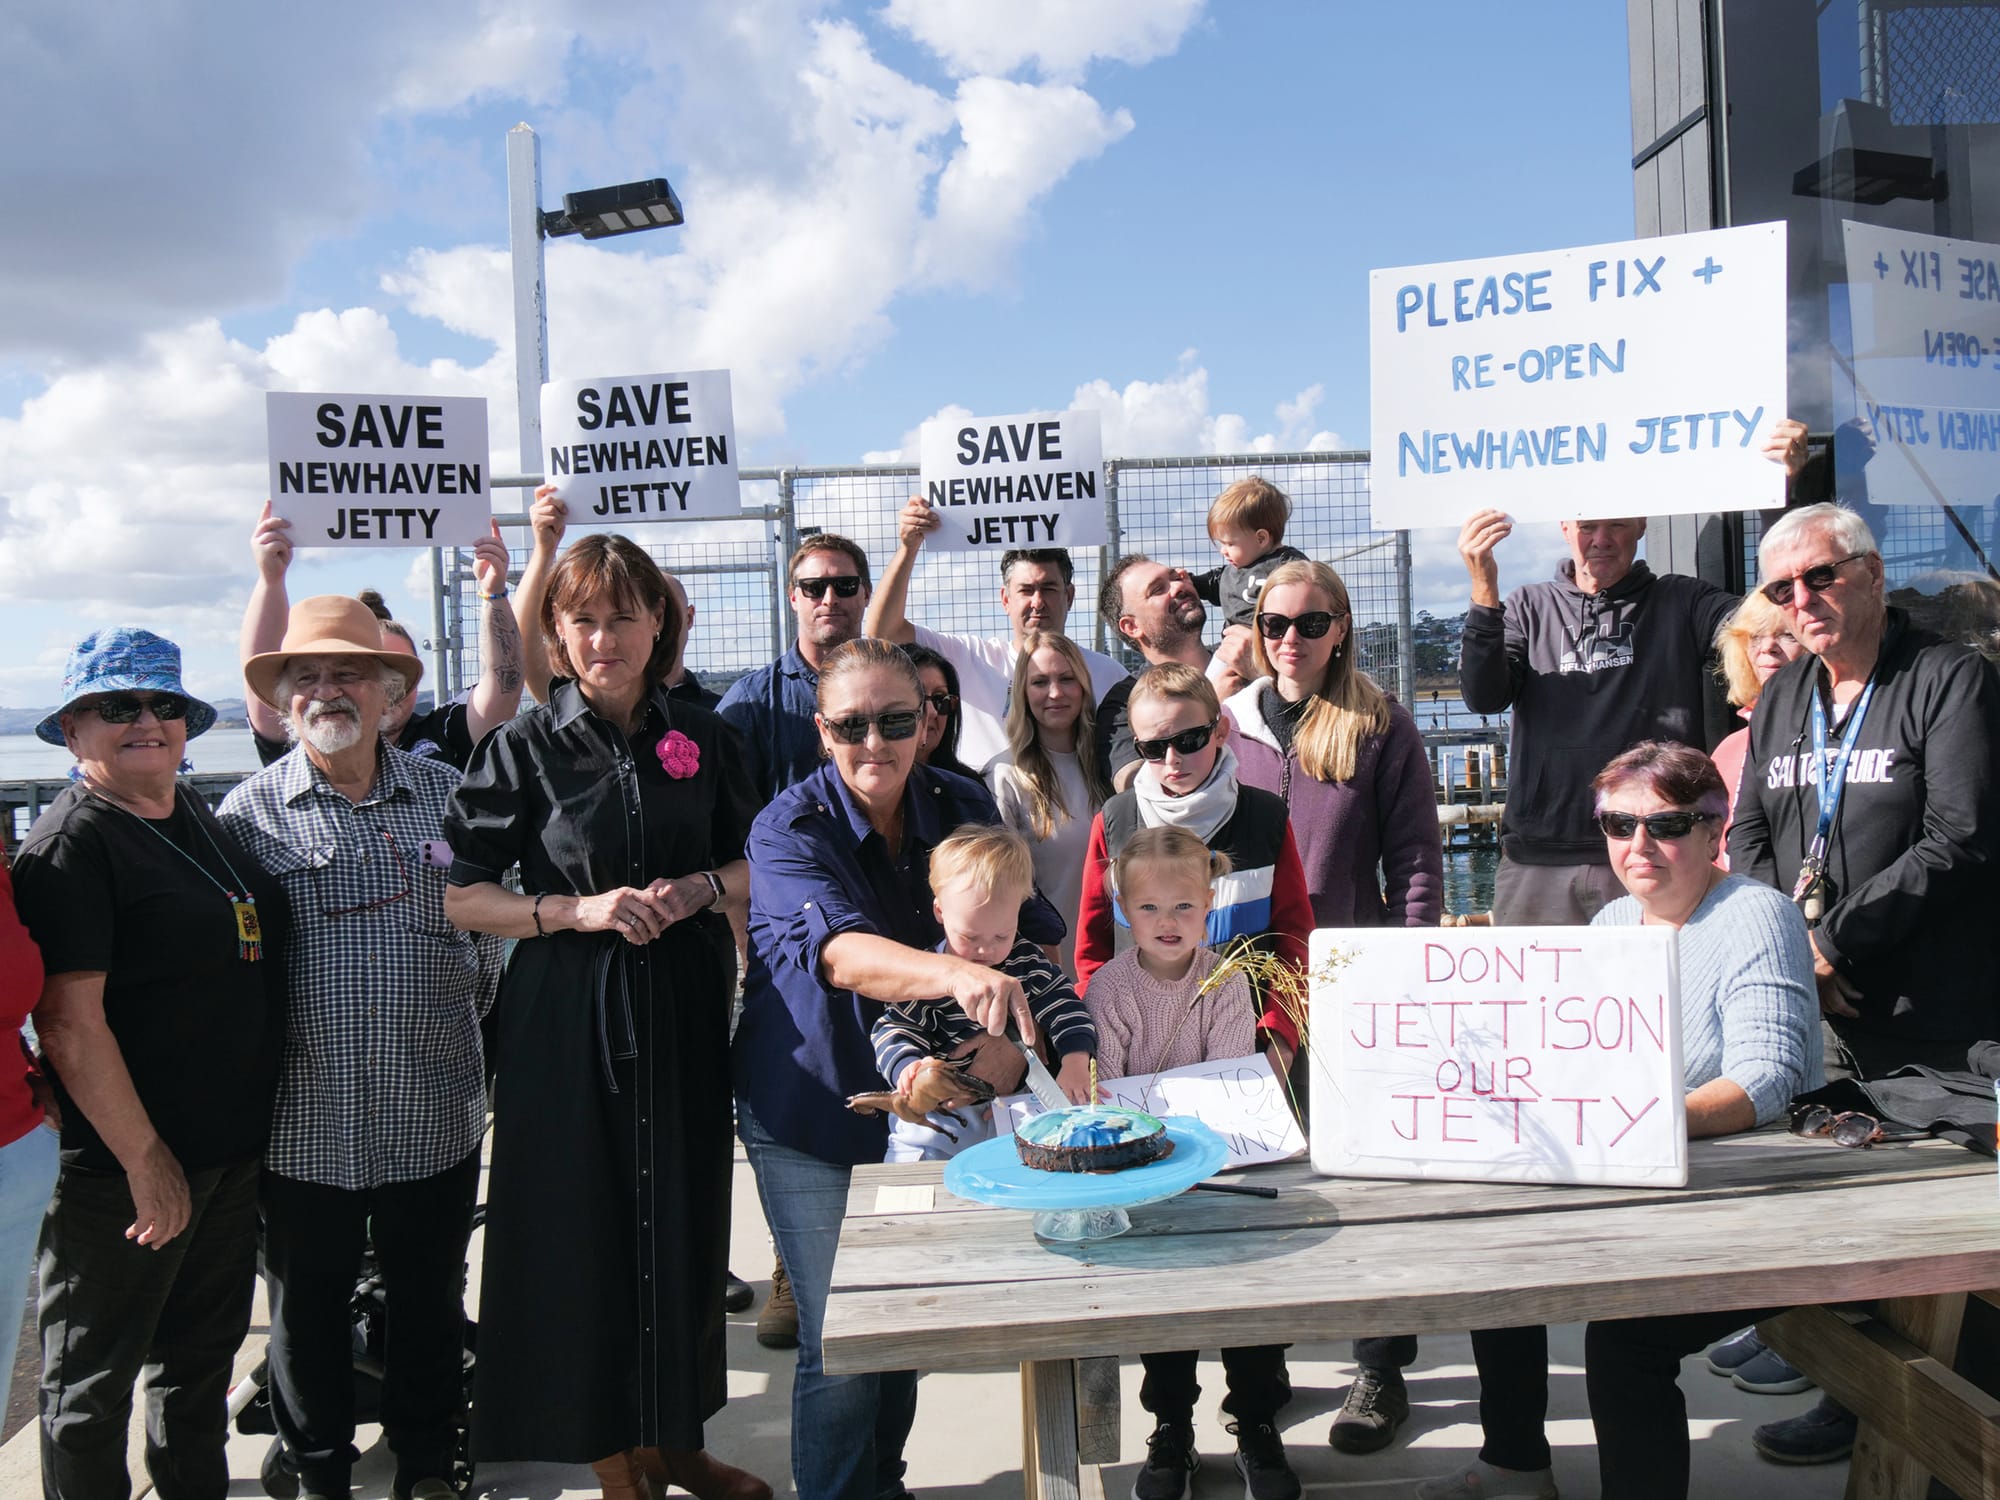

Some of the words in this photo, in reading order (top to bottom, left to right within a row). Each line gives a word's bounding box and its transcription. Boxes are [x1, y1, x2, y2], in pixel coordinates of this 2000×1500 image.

[1396, 269, 1553, 332] PLEASE
[1588, 256, 1666, 303] FIX
[1452, 338, 1626, 391] RE-OPEN
[316, 402, 445, 449] SAVE
[578, 382, 692, 431] SAVE
[551, 435, 729, 476] NEWHAVEN
[957, 421, 1062, 466] SAVE
[1399, 424, 1607, 477] NEWHAVEN
[1629, 407, 1765, 455] JETTY
[279, 462, 482, 495] NEWHAVEN
[593, 481, 691, 517] JETTY
[928, 471, 1096, 508] NEWHAVEN
[327, 508, 441, 541] JETTY
[967, 513, 1060, 545] JETTY
[1560, 663, 1592, 674] HELLY
[1592, 655, 1634, 672] HANSEN
[1424, 942, 1583, 984] DON'T
[1201, 1067, 1265, 1099] TO
[1436, 1056, 1542, 1097] OUR
[1391, 1095, 1660, 1147] JETTY
